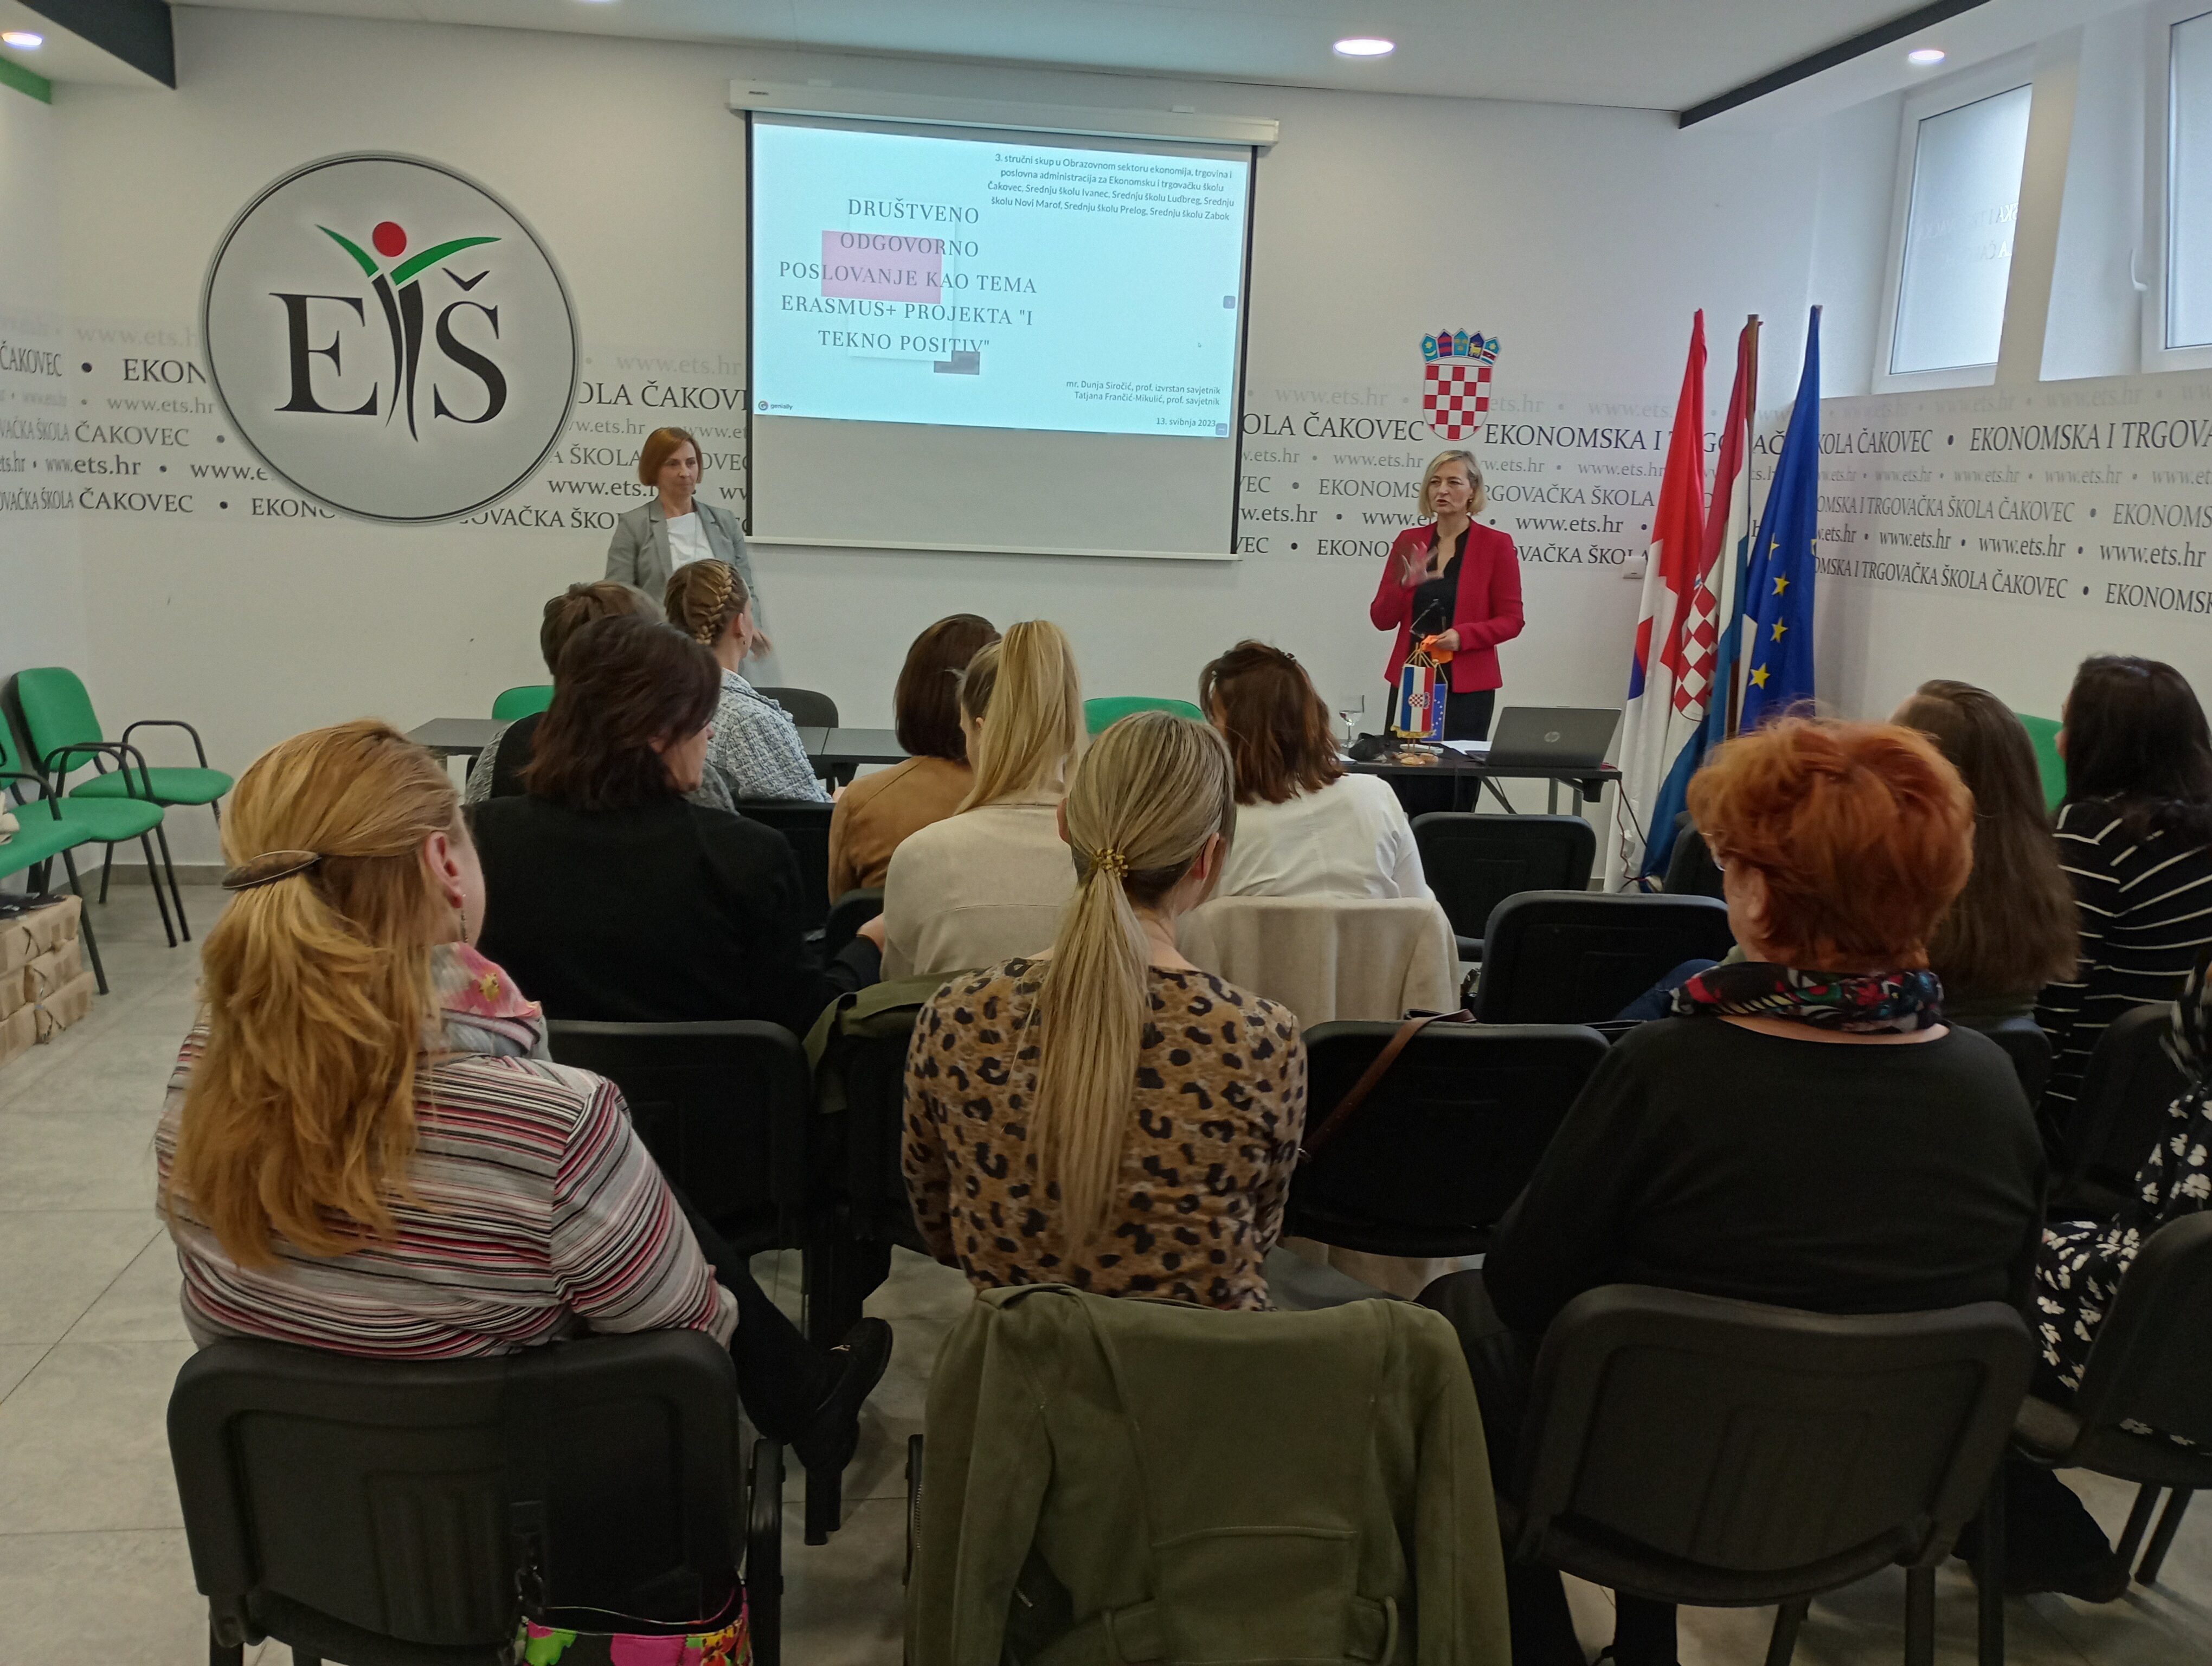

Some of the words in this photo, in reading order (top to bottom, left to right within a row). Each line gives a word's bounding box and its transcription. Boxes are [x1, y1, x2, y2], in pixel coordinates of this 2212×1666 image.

[995, 153, 1003, 162] 3.
[1005, 155, 1033, 164] stručni
[1035, 157, 1054, 166] skup
[1063, 158, 1116, 170] Obrazovnom
[1117, 163, 1148, 172] sektoru
[1195, 169, 1228, 178] trgovina
[1001, 169, 1038, 178] poslovna
[1040, 171, 1096, 184] administracija
[1109, 176, 1155, 187] Ekonomsku
[1162, 180, 1201, 190] trgovačku
[1203, 183, 1224, 191] školu
[988, 181, 1024, 192] Čakovec,
[1026, 184, 1057, 195] Srednju
[1059, 187, 1080, 196] školu
[1112, 190, 1143, 201] Srednju
[1145, 193, 1166, 202] školu
[1204, 197, 1234, 208] Srednju
[848, 198, 979, 224] DRUŠTVENO
[991, 196, 1013, 205] školu
[1015, 198, 1034, 207] Novi
[1036, 200, 1062, 209] Marof,
[1064, 202, 1095, 213] Srednju
[1097, 203, 1118, 213] školu
[1150, 208, 1180, 219] Srednju
[1182, 210, 1203, 219] školu
[1205, 212, 1230, 221] Zabok
[840, 232, 979, 257] ODGOVORNO
[780, 261, 917, 286] POSLOVANJE
[925, 271, 969, 289] KAO
[976, 275, 1037, 294] TEMA
[781, 295, 897, 317] ERASMUS+
[904, 304, 1012, 325] PROJEKTA
[77, 326, 198, 348] www.ets.h
[818, 330, 891, 350] TEKNO
[0, 340, 62, 376] ČAKOVEC
[1075, 391, 1103, 401] Tatjana
[1166, 396, 1184, 405] prof.
[1185, 398, 1220, 406] savjetnik
[1081, 380, 1104, 390] Dunja
[1135, 383, 1153, 392] prof.
[1155, 385, 1185, 393] izvrstan
[1186, 386, 1220, 396] savjetnik
[107, 397, 216, 415] www.ets.hr
[75, 420, 189, 446] ČAKOVEC
[1169, 419, 1196, 427] svibnja
[1303, 412, 1424, 441] ČAKOVEC
[1484, 424, 1647, 450] EKONOMSKA
[1857, 428, 1933, 454] ČAKOVEC
[1970, 422, 2100, 451] EKONOMSKA
[2106, 422, 2116, 448] I
[45, 454, 141, 475] www.ets.hr
[1334, 450, 1423, 468] www.ets.hr
[79, 488, 194, 512] ČAKOVEC
[1591, 485, 1655, 506] ŠKOLA
[1868, 495, 1944, 517] TRGOVAČKA
[1948, 495, 1994, 518] ŠKOLA
[1998, 496, 2075, 522] ČAKOVEC
[1516, 515, 1624, 533] www.ets.hr
[1880, 528, 1951, 549] www.ets.hr
[1979, 534, 2066, 557] www.ets.hr
[2100, 541, 2206, 567] www.ets.hr
[1862, 561, 1937, 586] TRGOVAČKA
[1941, 565, 1988, 590] ŠKOLA
[1992, 569, 2068, 598] ČAKOVEC
